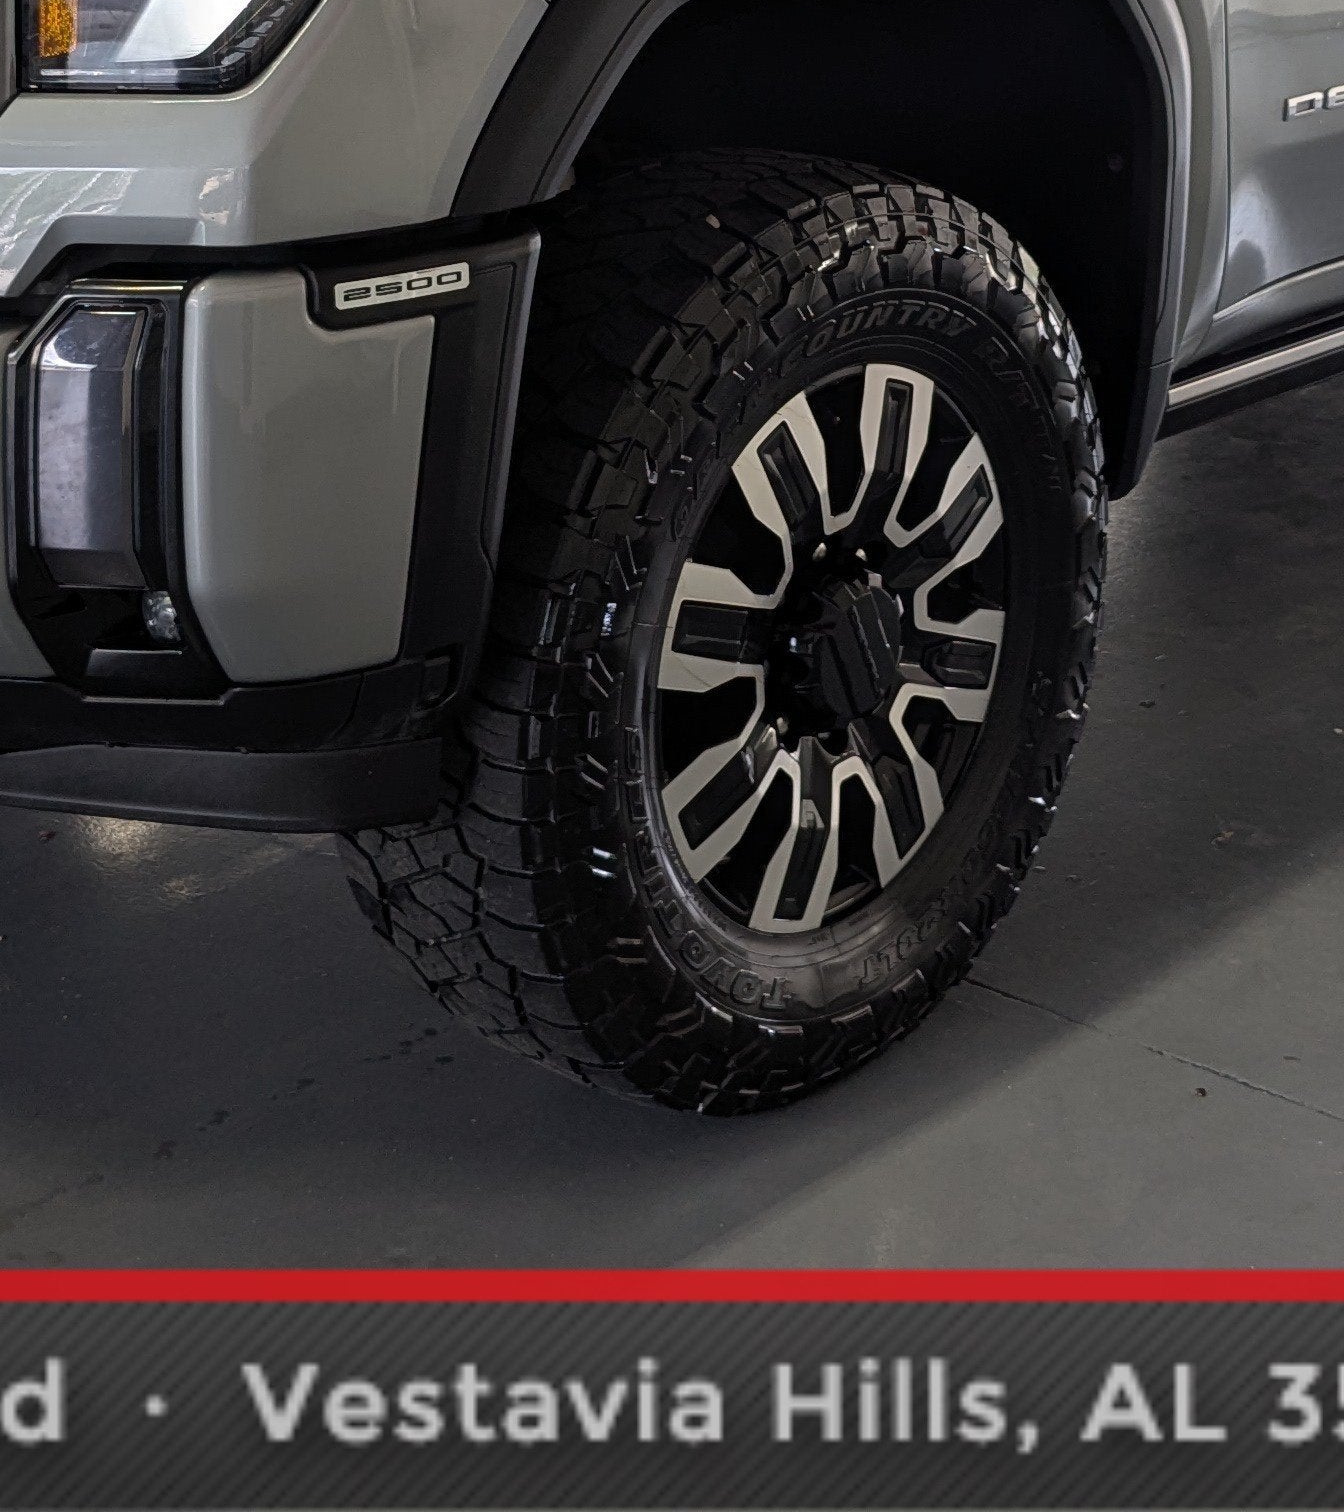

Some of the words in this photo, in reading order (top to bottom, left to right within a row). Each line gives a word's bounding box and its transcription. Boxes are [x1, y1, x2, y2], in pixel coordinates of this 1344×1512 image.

[342, 270, 463, 303] 2500
[776, 297, 981, 379] COUNTRY
[676, 923, 795, 1010] TOYO
